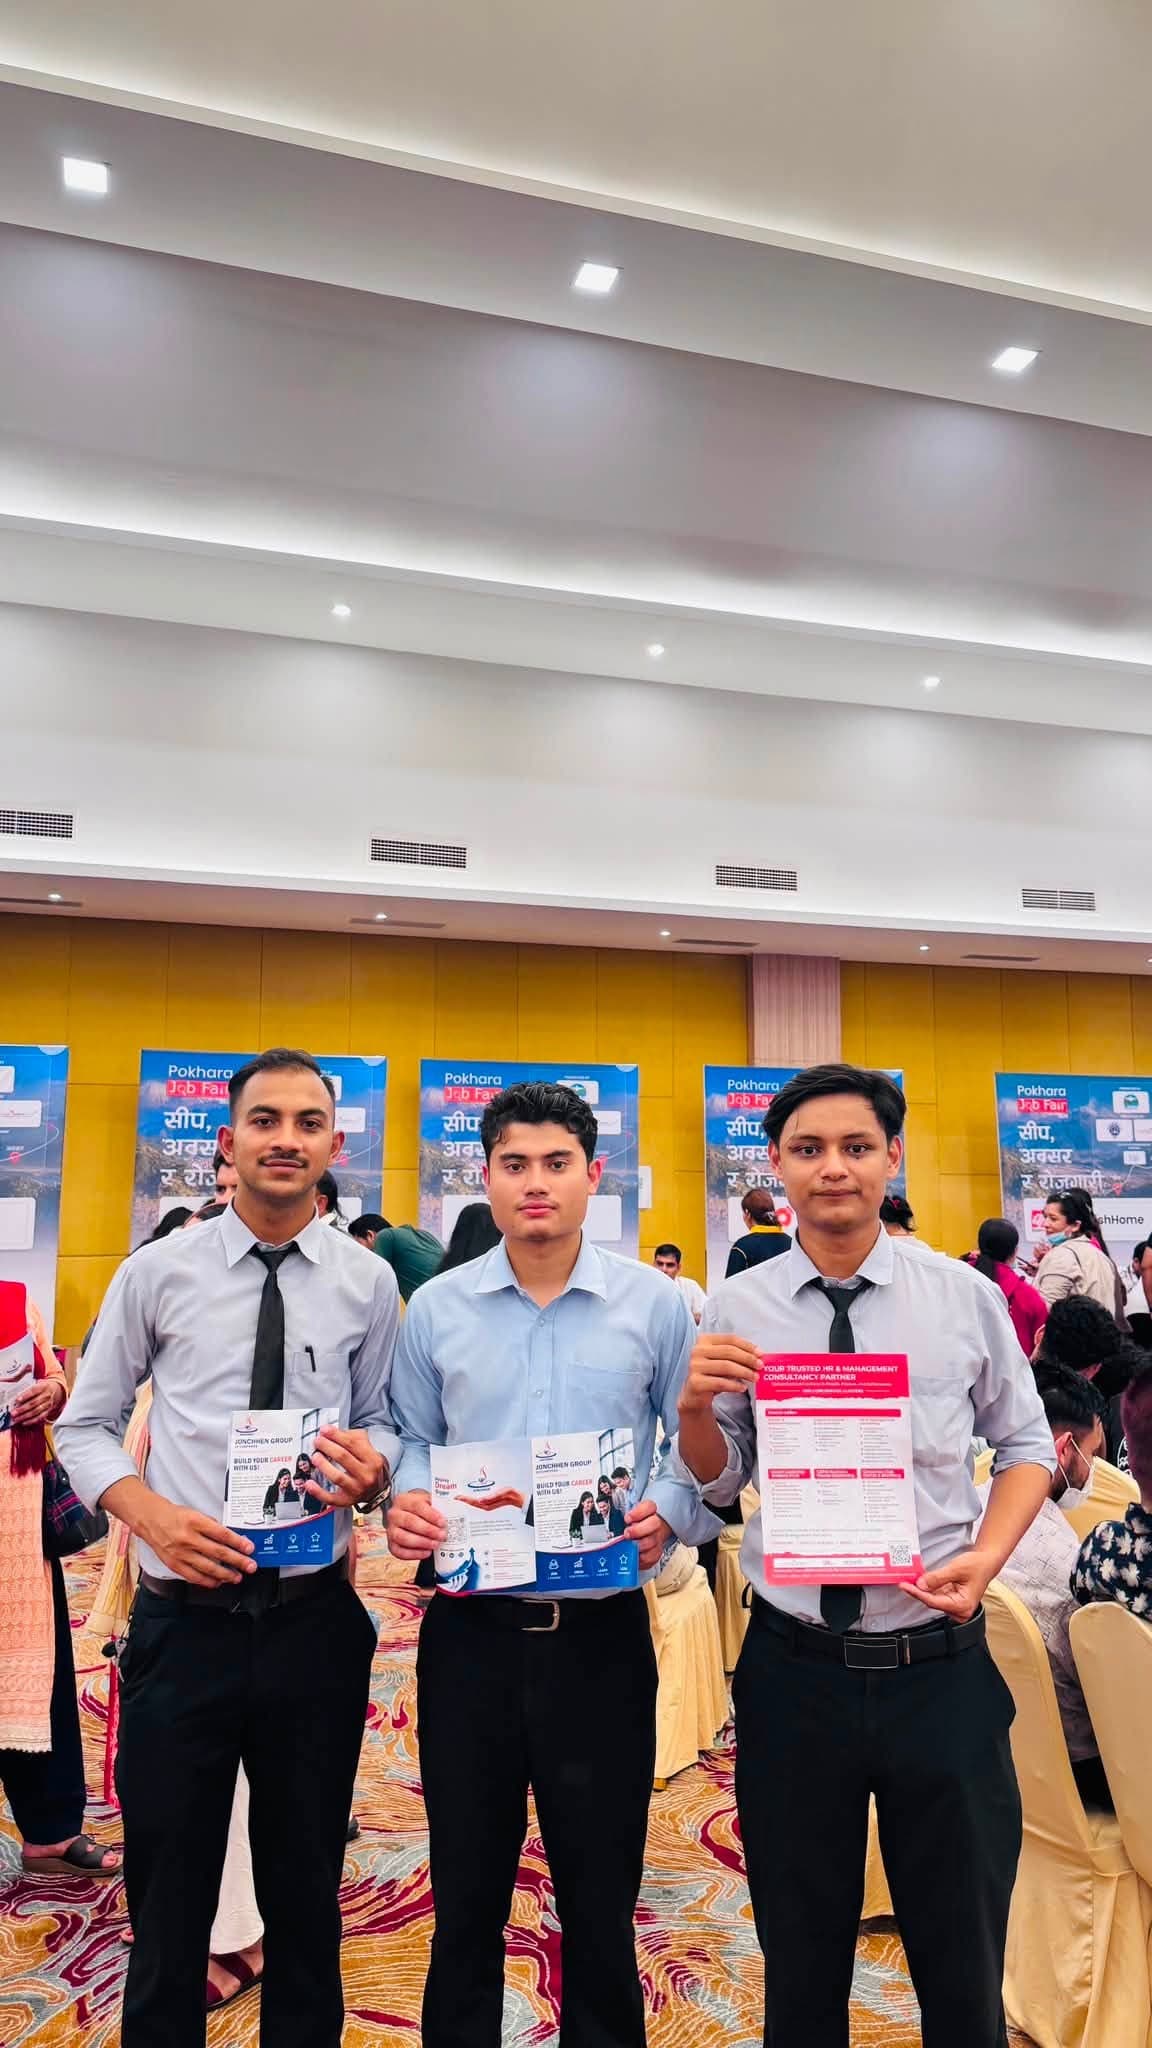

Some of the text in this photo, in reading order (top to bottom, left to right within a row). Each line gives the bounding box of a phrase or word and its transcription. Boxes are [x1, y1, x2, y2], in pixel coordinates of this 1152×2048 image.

[168, 1065, 233, 1079] Pokhara
[445, 1072, 502, 1085] Pokhara
[168, 1081, 196, 1096] Job
[727, 1080, 779, 1091] Pokhara
[1016, 1085, 1067, 1097] Pokhara
[445, 1087, 500, 1101] Job Fa
[728, 1093, 771, 1106] Job Fa
[1018, 1099, 1067, 1112] Job Fair
[163, 1106, 212, 1132] सीप,
[441, 1111, 481, 1132] सीप
[725, 1116, 764, 1139] सीप,
[1017, 1120, 1055, 1144] सीप,
[161, 1138, 218, 1156] अवस
[725, 1145, 769, 1161] अवस
[1019, 1148, 1072, 1164] अवसर
[1020, 1170, 1104, 1190] र रोजगारी
[1099, 1215, 1145, 1225] shHome
[787, 1365, 821, 1373] TRUSTED
[569, 1460, 592, 1468] GROUP
